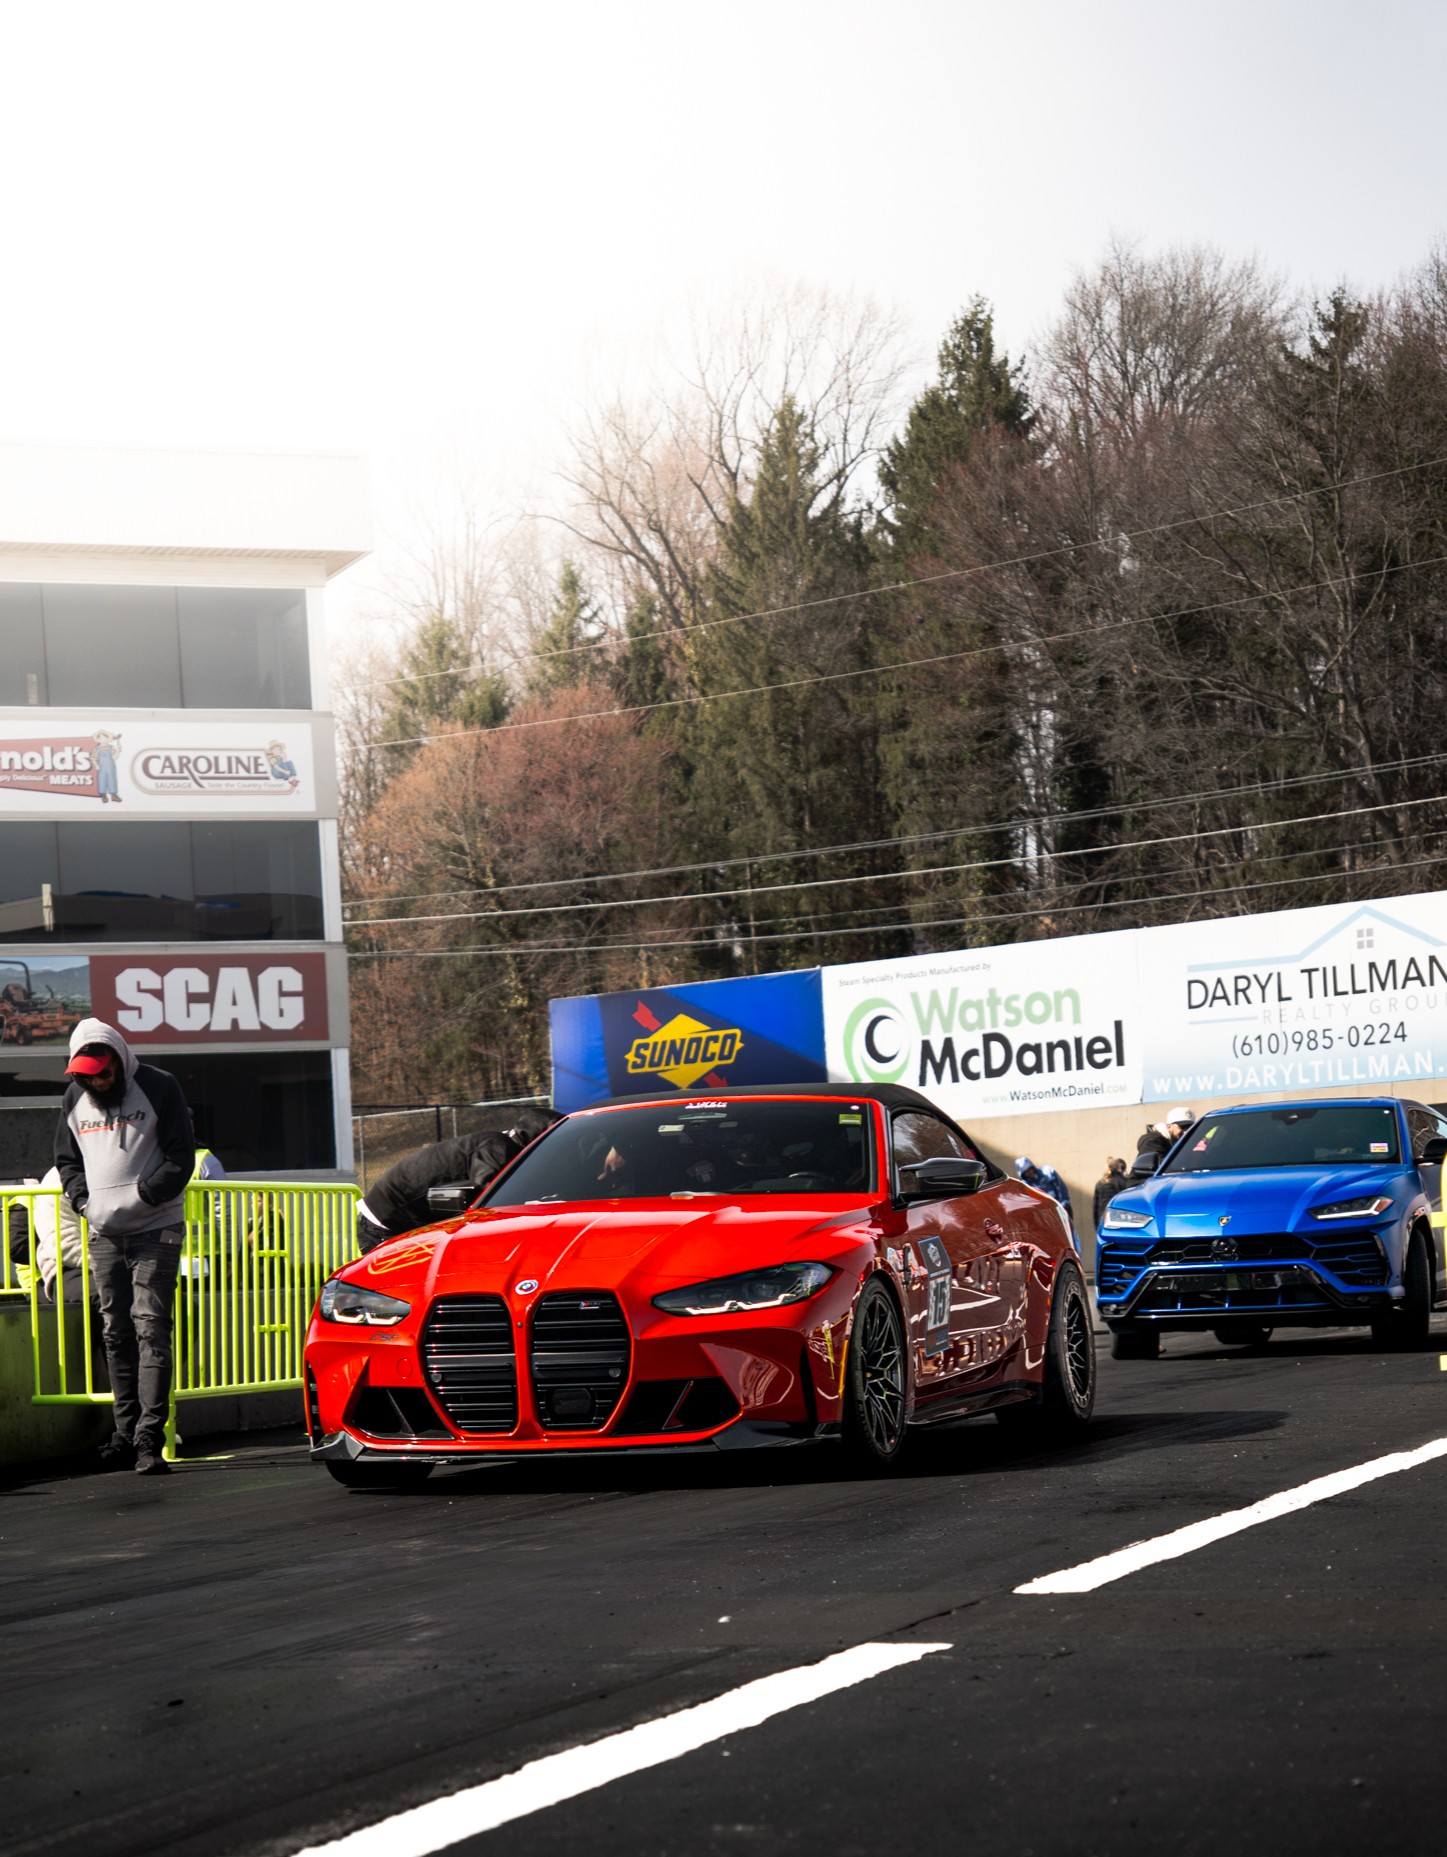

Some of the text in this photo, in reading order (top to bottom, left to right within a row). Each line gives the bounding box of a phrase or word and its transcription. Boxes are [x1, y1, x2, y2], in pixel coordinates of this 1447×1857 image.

[0, 746, 92, 771] nold's
[142, 755, 270, 785] CAROLINE
[49, 774, 93, 785] MEATS
[838, 962, 992, 987] Steam Specialty Products Manufactured by
[1187, 954, 1447, 1010] DARYL TILLMAN
[115, 966, 305, 1033] SCAG
[910, 987, 1082, 1037] Watson
[1263, 992, 1447, 1025] REALTY GROU
[630, 1030, 740, 1071] SUNOCO
[918, 1019, 1126, 1087] McDaniel
[1232, 1020, 1408, 1059] (610)985-0224
[80, 1109, 146, 1130] FuelTech
[933, 1281, 947, 1326] 15
